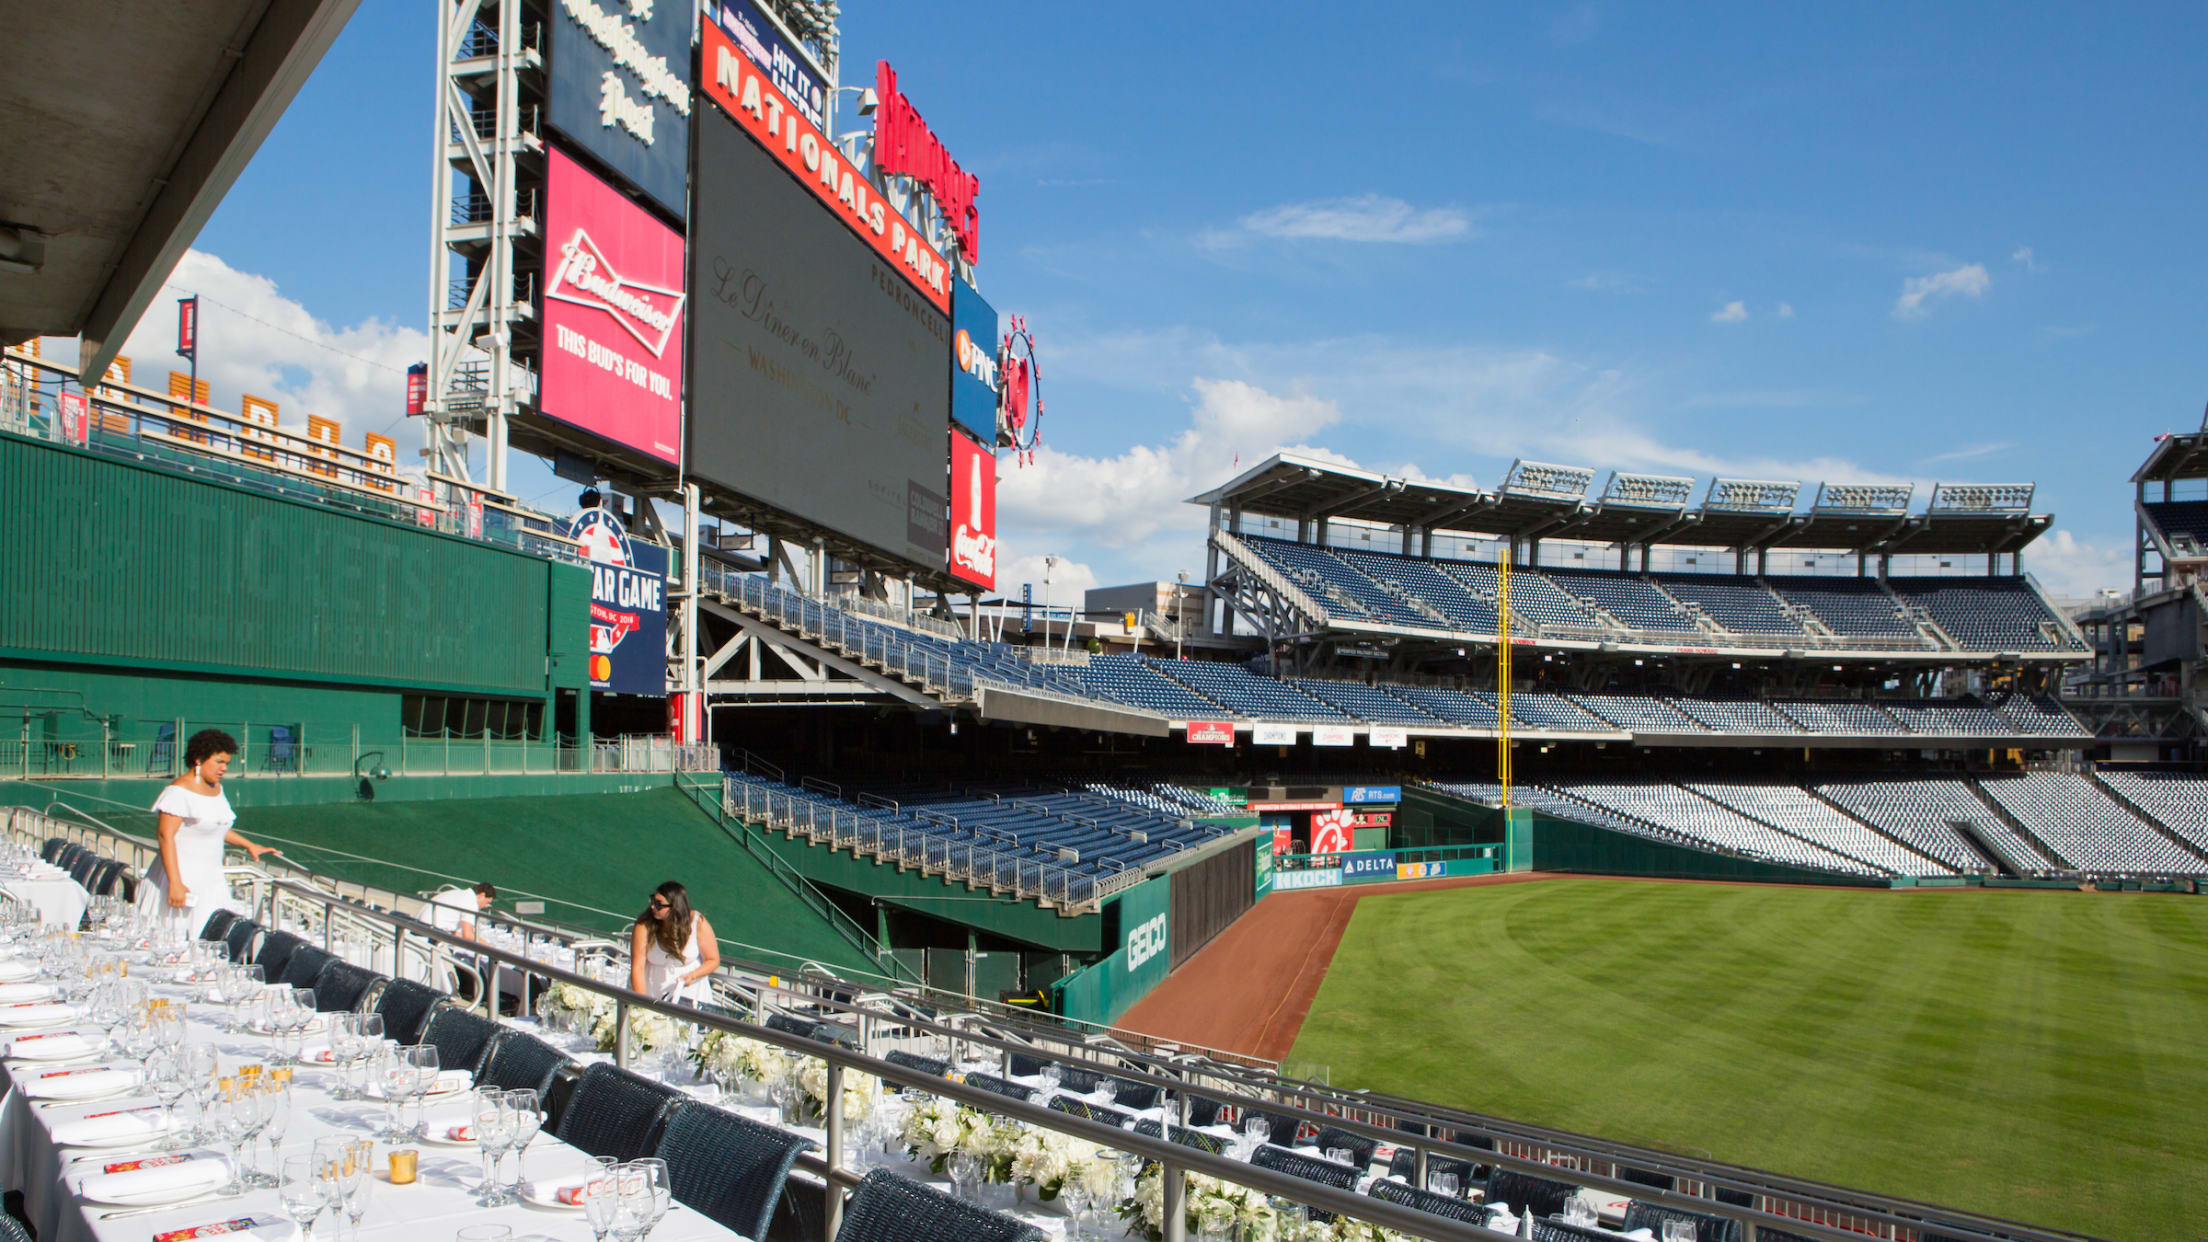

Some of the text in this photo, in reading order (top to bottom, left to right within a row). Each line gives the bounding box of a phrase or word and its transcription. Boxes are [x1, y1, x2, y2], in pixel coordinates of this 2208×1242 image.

[773, 42, 811, 99] HIT IT
[717, 45, 945, 295] NATIONALS PARK
[561, 243, 672, 333] Budweiser
[556, 323, 673, 401] THIS BUD'S FOR YOU.
[969, 341, 998, 393] PNC
[592, 567, 661, 612] AR GAME
[1293, 869, 1338, 888] KOCH
[1356, 858, 1395, 872] DELTA
[1128, 912, 1166, 972] GEICO
